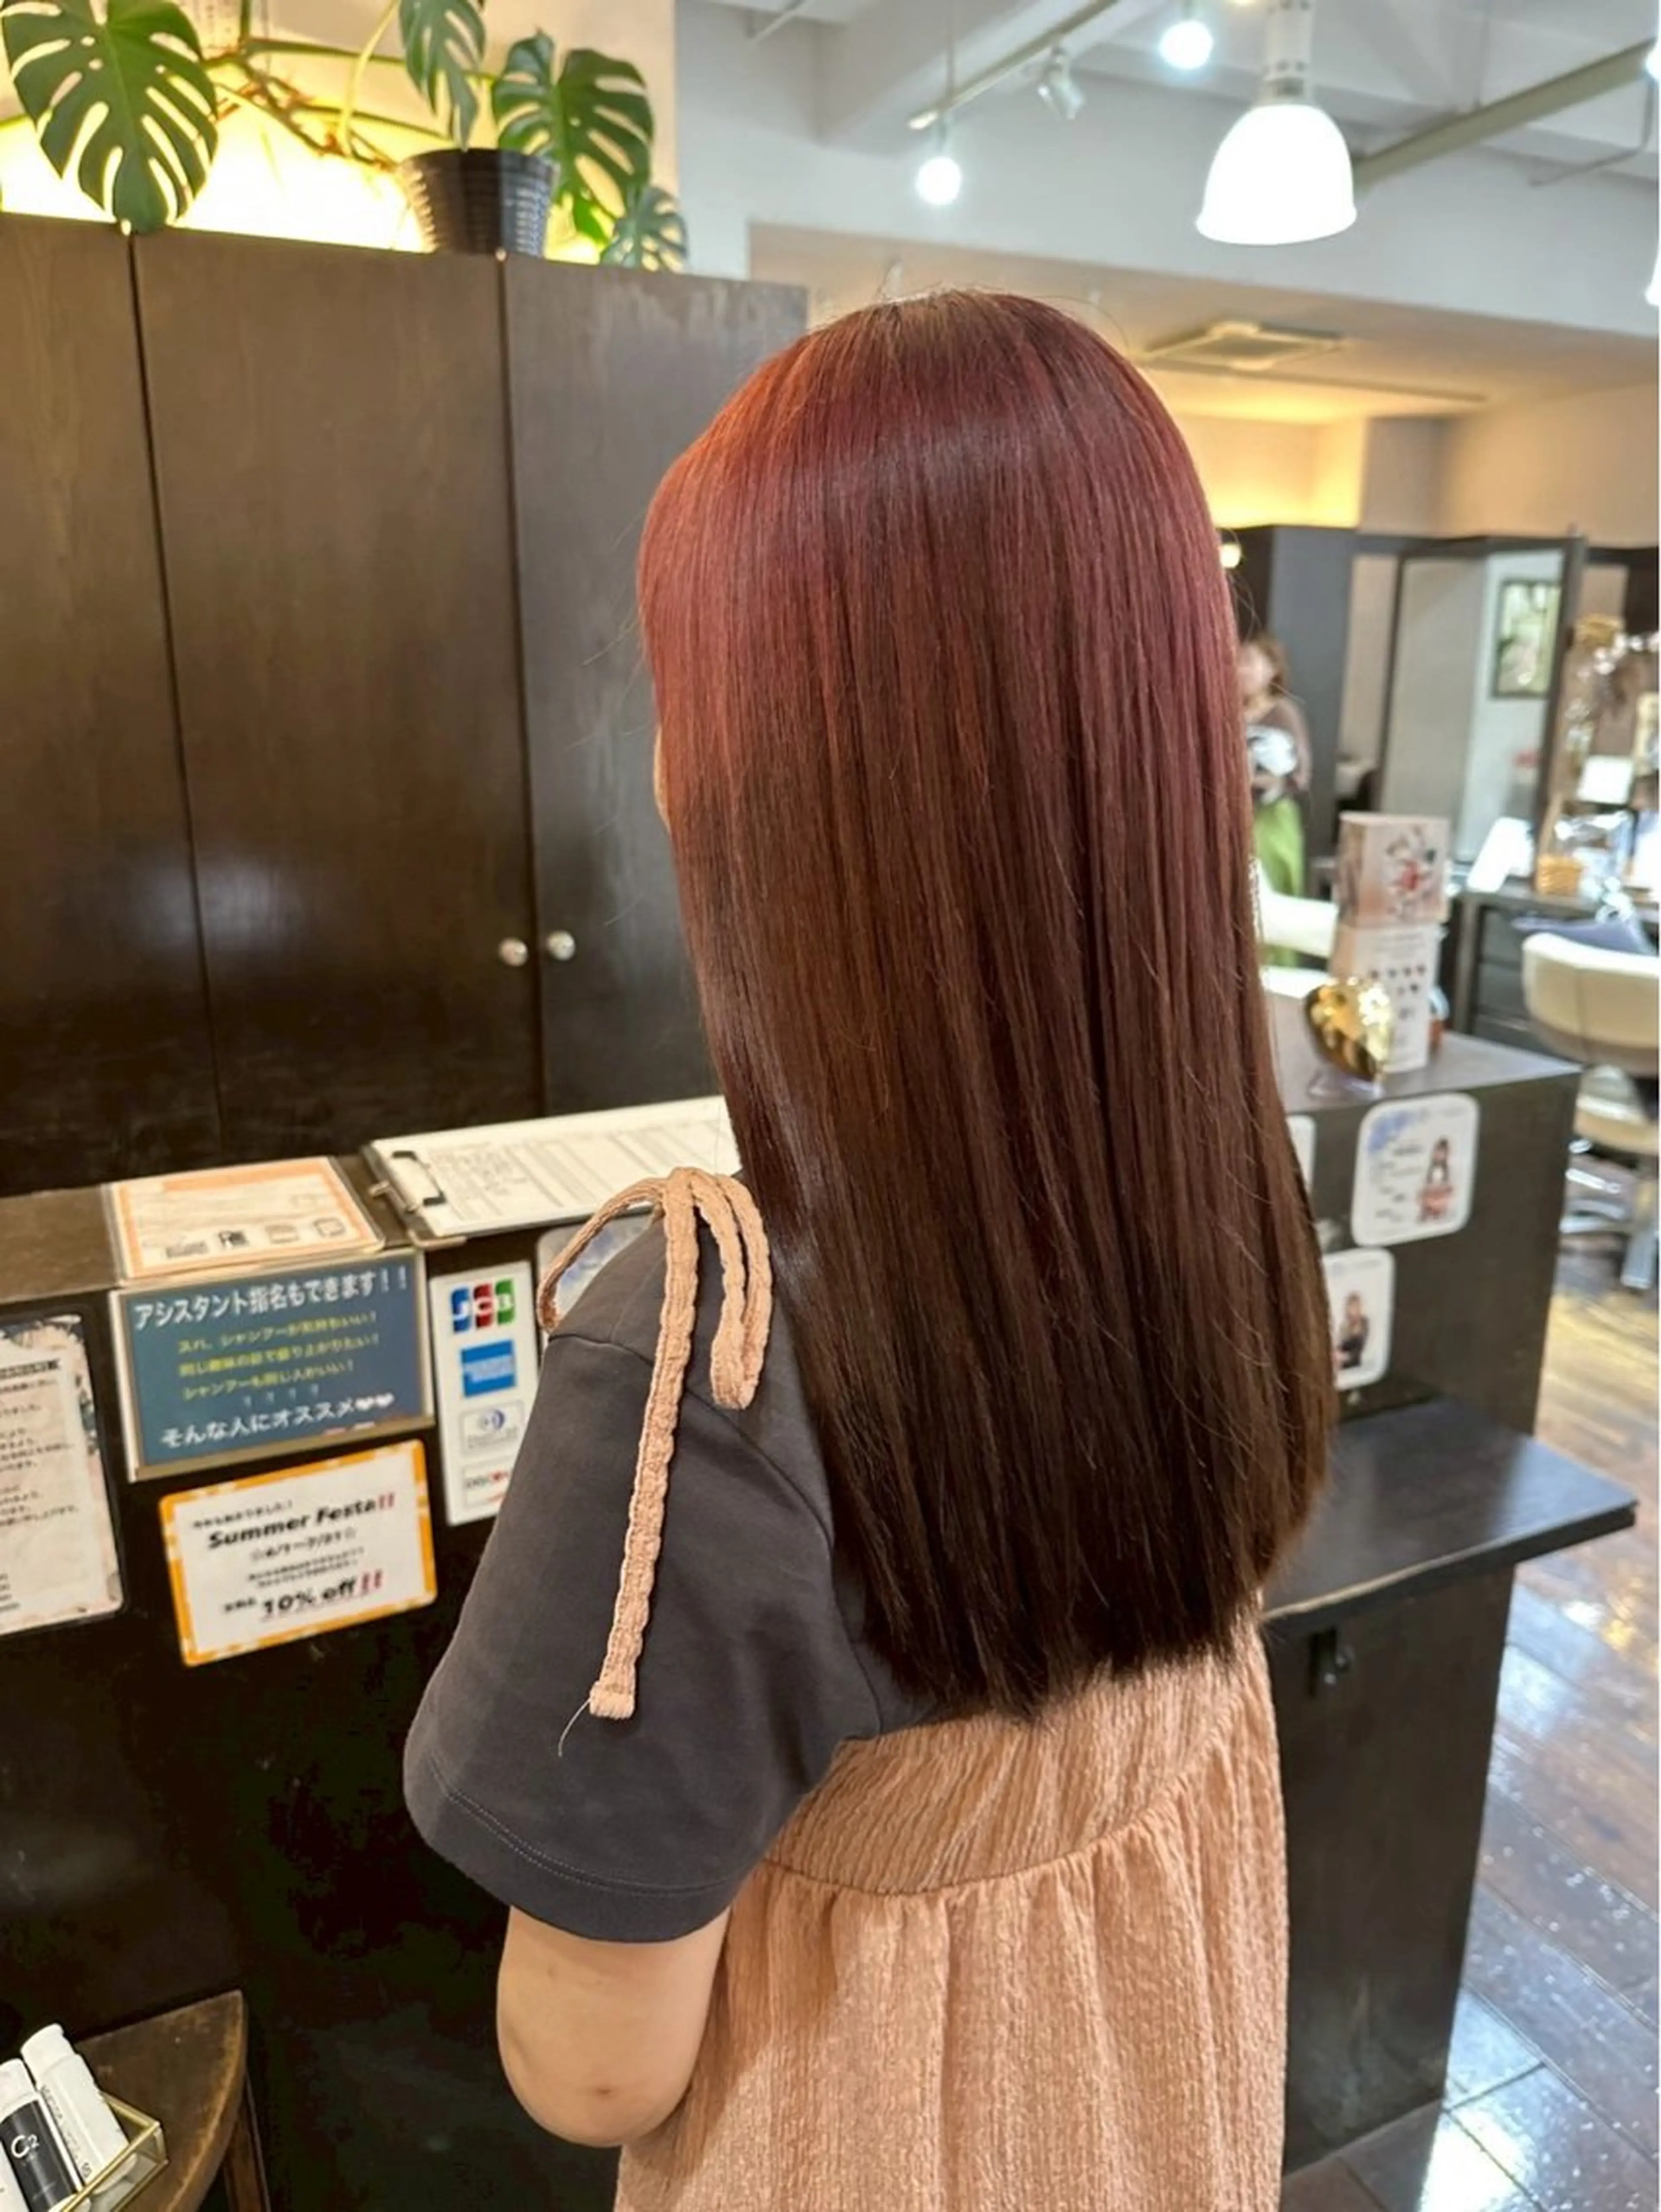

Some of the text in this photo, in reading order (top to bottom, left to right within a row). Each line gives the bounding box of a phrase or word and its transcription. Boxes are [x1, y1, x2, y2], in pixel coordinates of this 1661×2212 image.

[450, 1278, 515, 1333] JCB
[208, 1512, 310, 1550] Summer
[263, 1587, 316, 1616] 10%
